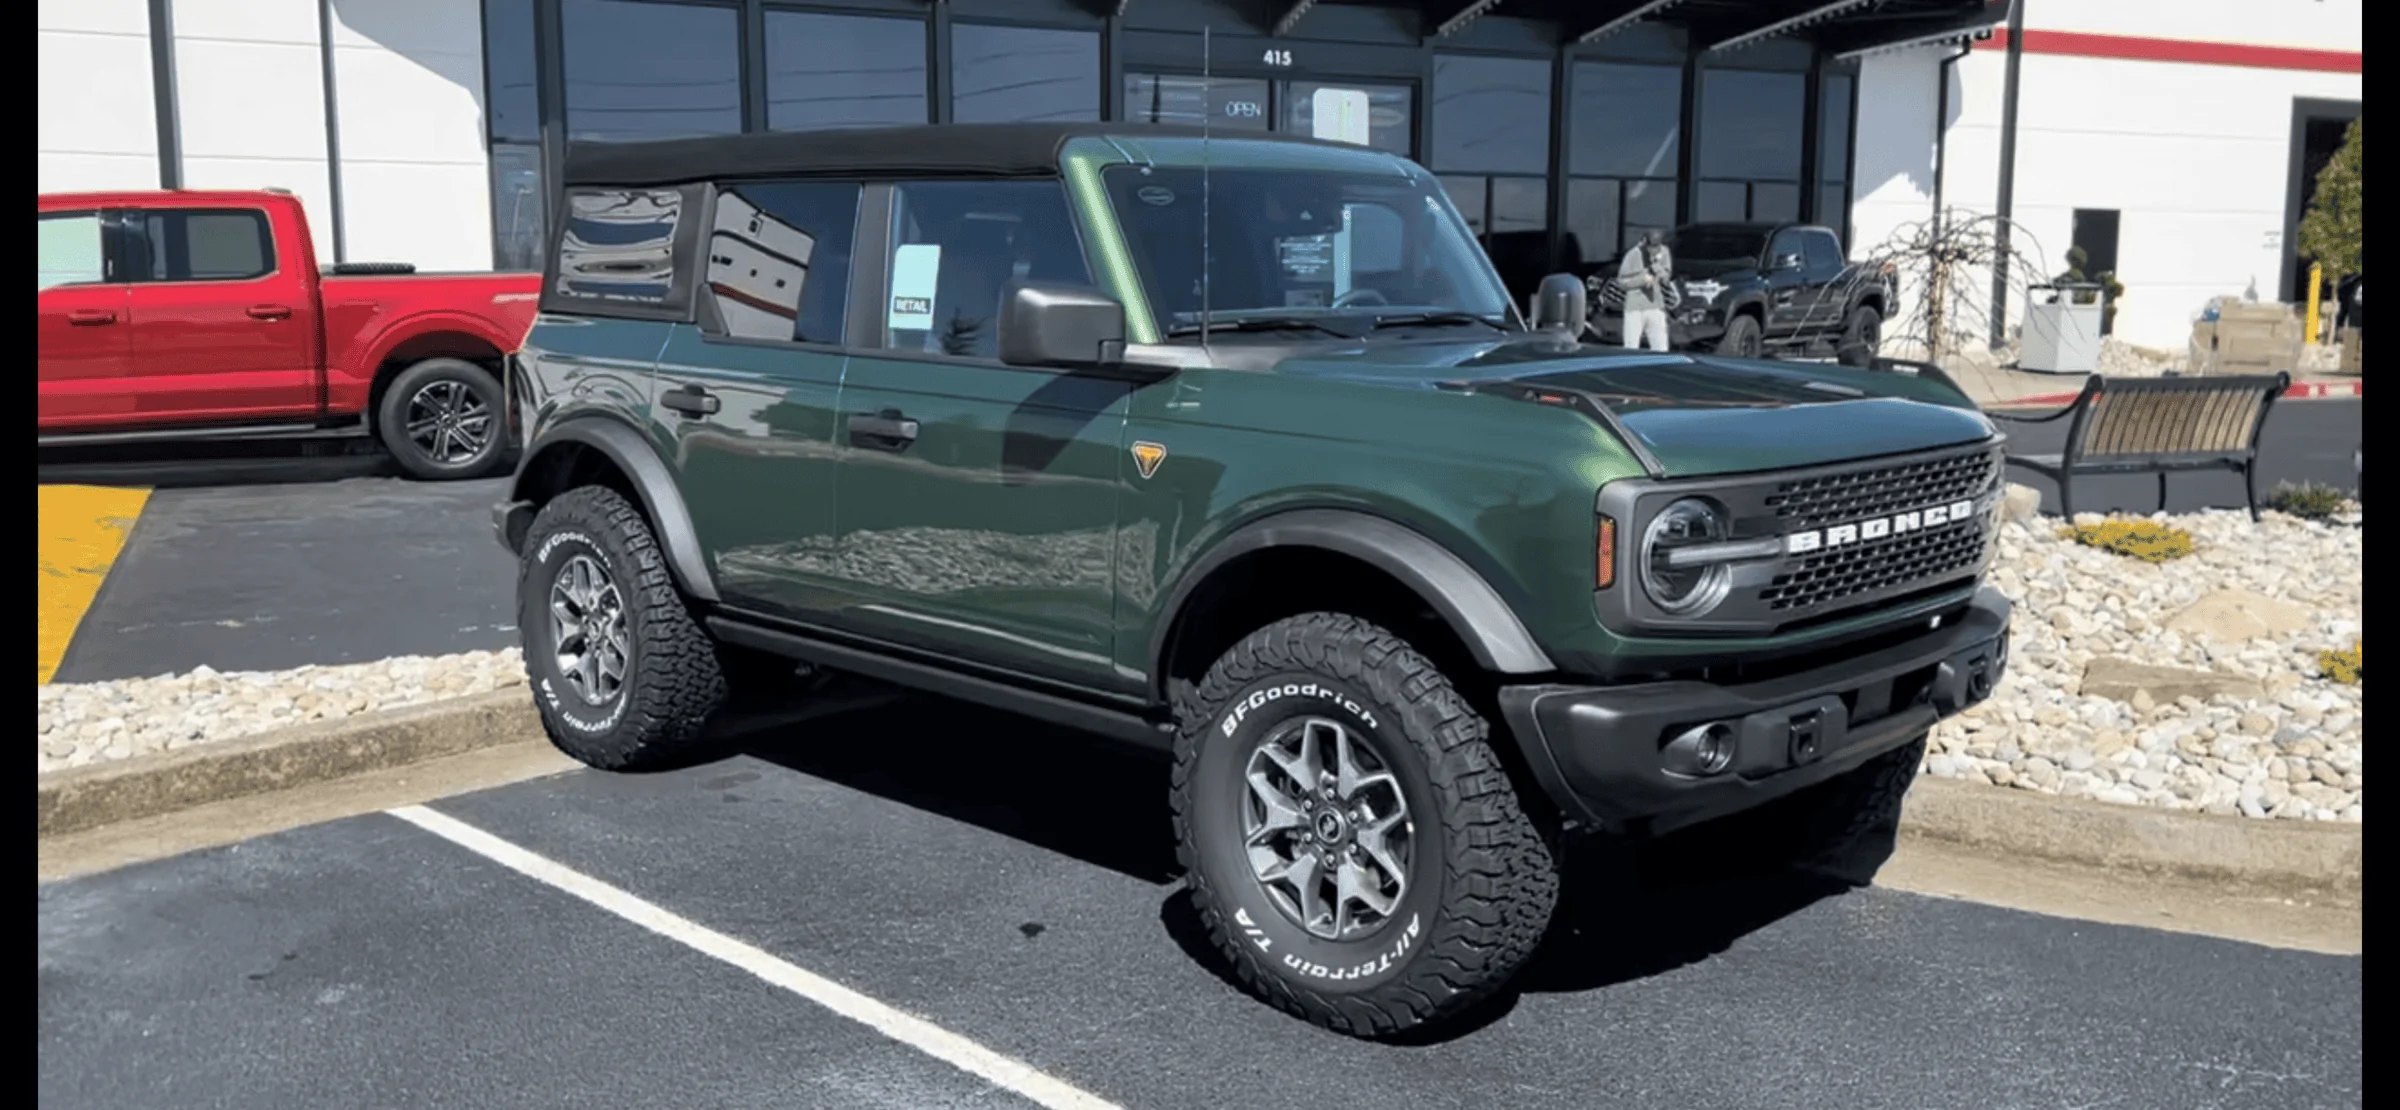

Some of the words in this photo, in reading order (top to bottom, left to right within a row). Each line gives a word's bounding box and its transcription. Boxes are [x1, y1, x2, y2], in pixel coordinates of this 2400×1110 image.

[1263, 50, 1292, 66] 415
[1225, 101, 1262, 117] OPEN
[896, 299, 928, 313] RETAIL
[1788, 500, 1972, 553] BRONCO
[1221, 683, 1378, 738] BFGoodrich
[1234, 907, 1273, 953] T/A
[1283, 912, 1420, 980] All-Terrain
